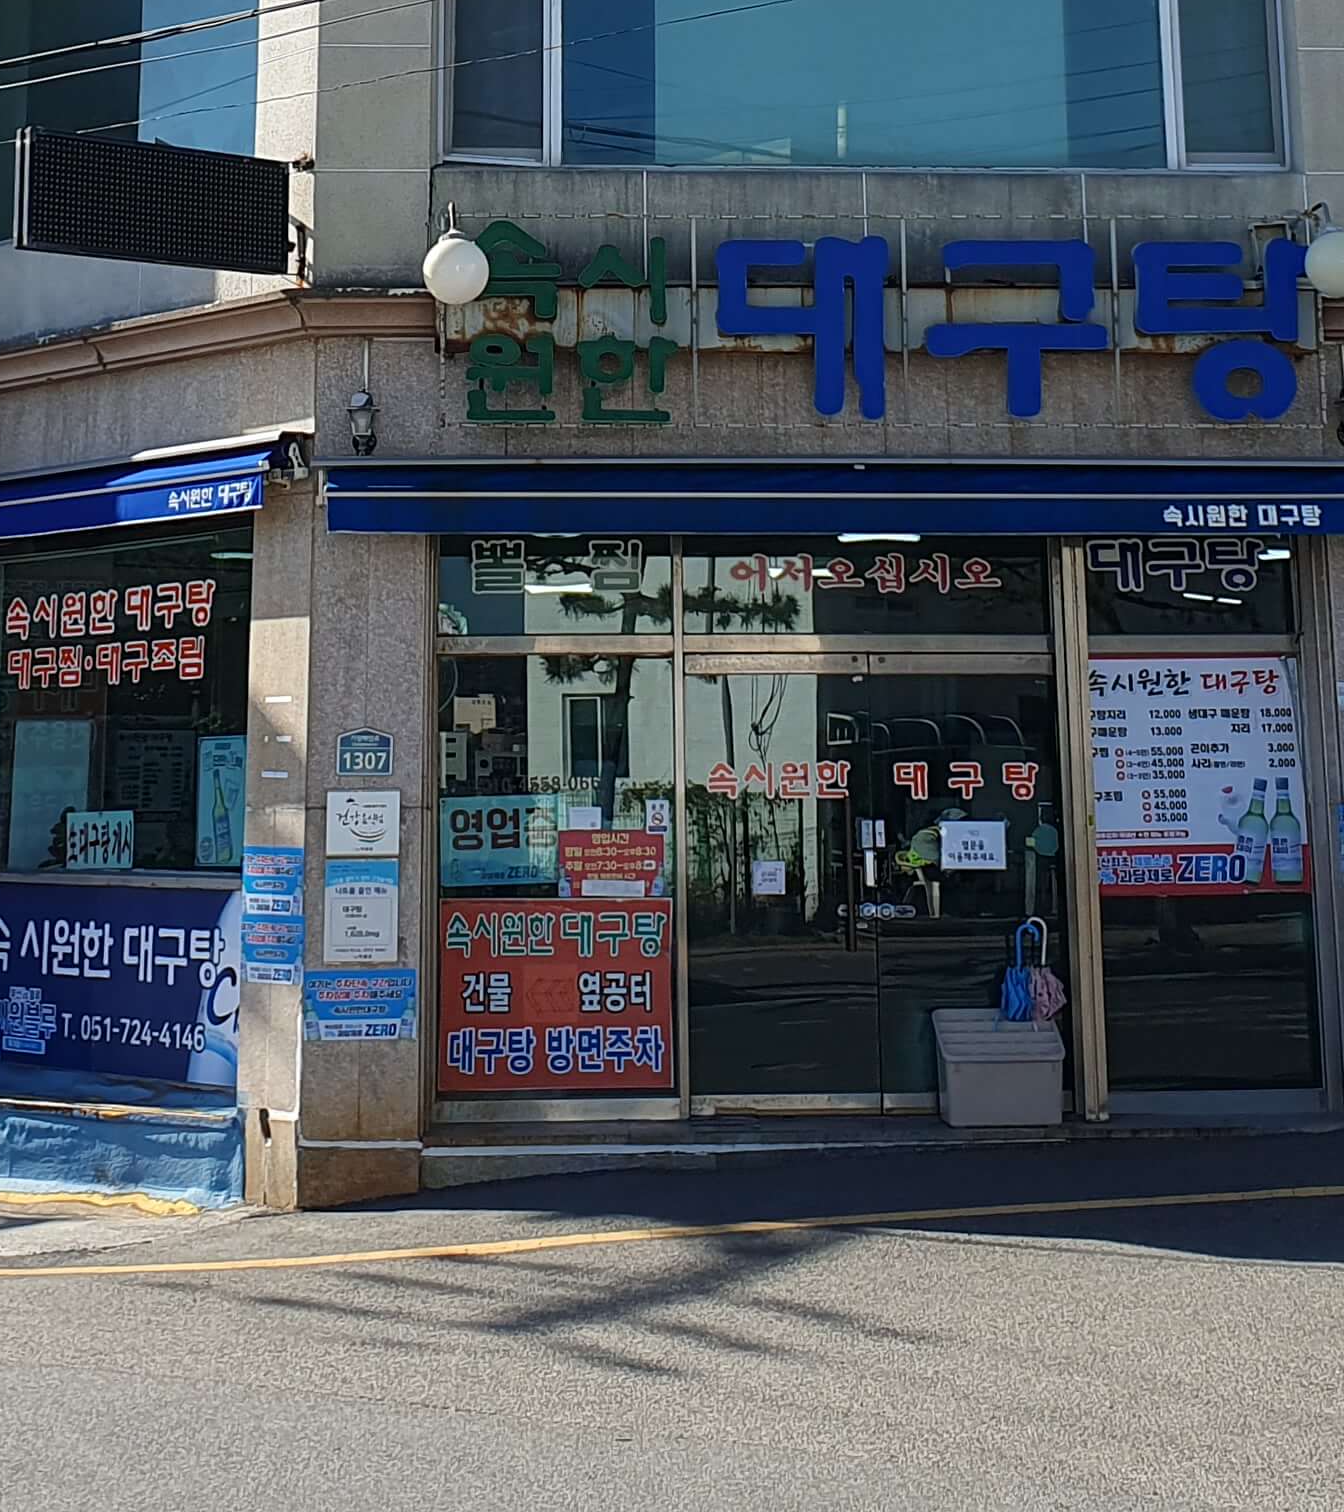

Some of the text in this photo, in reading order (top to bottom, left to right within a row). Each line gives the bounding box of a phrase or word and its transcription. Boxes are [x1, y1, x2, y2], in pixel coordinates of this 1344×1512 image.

[479, 219, 668, 324] 속시
[715, 235, 1309, 419] 대구탕
[466, 333, 678, 423] 원한
[168, 480, 253, 511] 속시원한 대구탕
[1162, 505, 1322, 527] 속시원한 대구탕
[729, 551, 1002, 593] 어서오십시오
[1087, 536, 1266, 592] 대구탕
[6, 579, 216, 640] 속시원한 대구탕
[1089, 668, 1280, 696] 속시원한 대구탕
[1231, 724, 1250, 734] 지리
[343, 752, 387, 769] 1307
[706, 760, 1039, 801] 속시원한 대구탕
[450, 807, 556, 851] 영업중
[1177, 855, 1246, 882] ZERO
[20, 919, 114, 979] 시원한
[122, 925, 226, 988] 대구탕
[445, 912, 668, 959] 속시원한 대구탕
[460, 970, 652, 1014] 건물 옆공터
[80, 1016, 205, 1051] 051-724-4146
[365, 1023, 397, 1036] ZERO
[447, 1026, 664, 1076] 대구탕 방면주차
